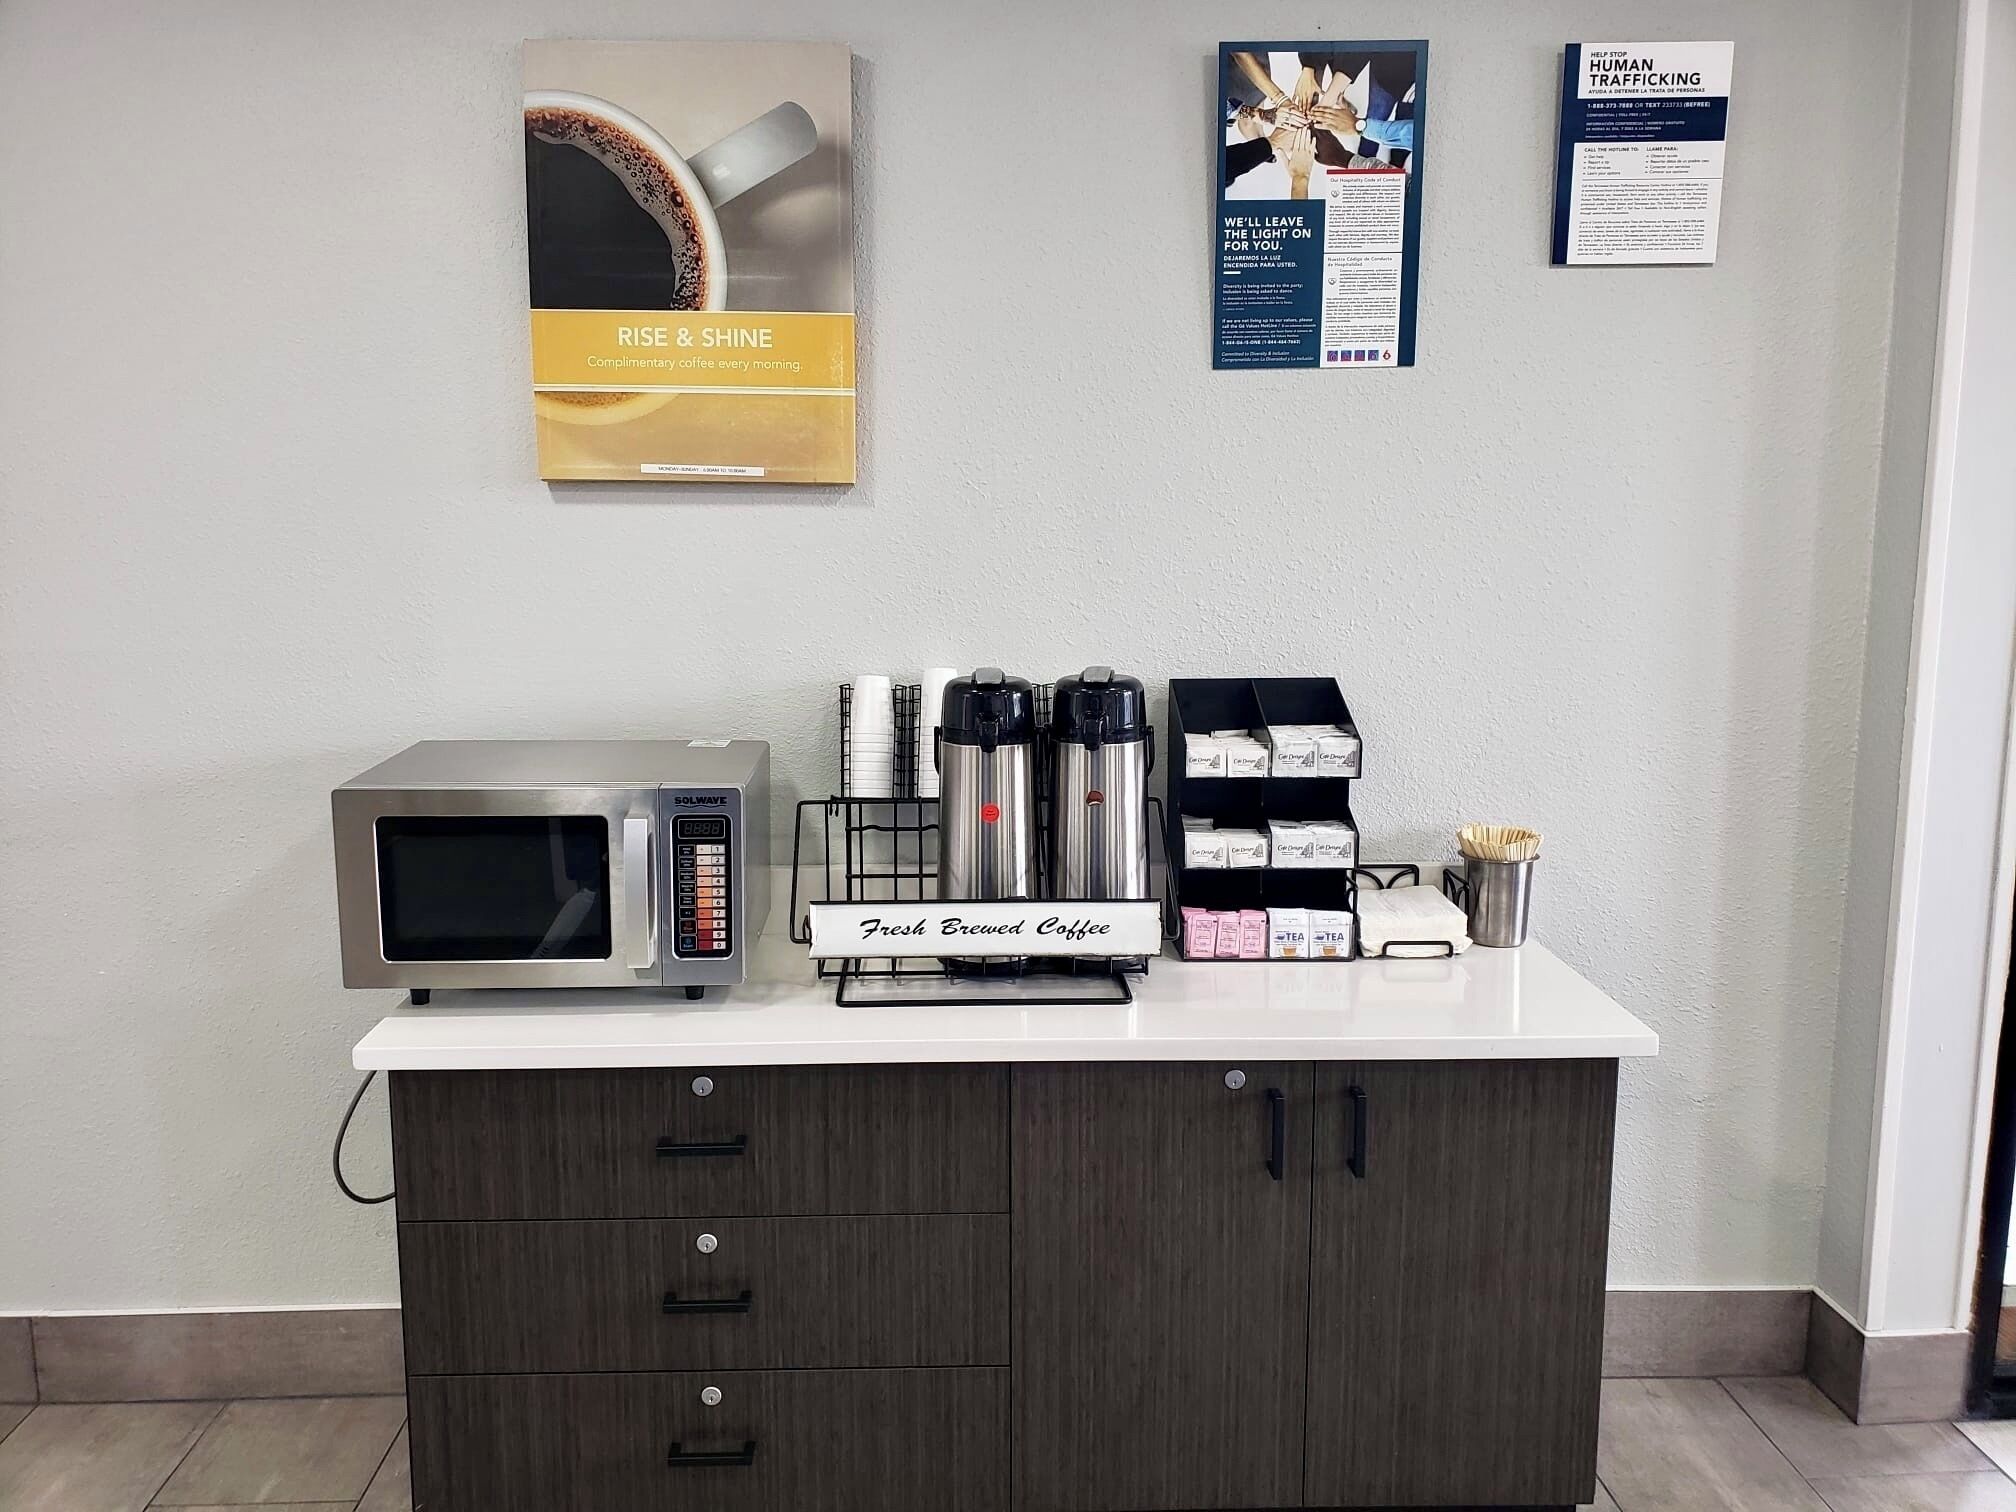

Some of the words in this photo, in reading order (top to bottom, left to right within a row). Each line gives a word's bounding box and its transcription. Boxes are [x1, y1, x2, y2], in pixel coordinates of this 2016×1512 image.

[1590, 58, 1653, 72] HUMAN
[1589, 72, 1701, 87] TRAFFICKING
[1224, 217, 1261, 227] WE'LL
[1265, 216, 1304, 227] LEAVE
[1224, 229, 1248, 239] THE
[1252, 229, 1288, 239] LIGHT
[1292, 228, 1312, 239] ON
[1224, 241, 1249, 251] FOR
[1253, 240, 1283, 251] YOU.
[618, 327, 668, 347] RISE
[676, 328, 693, 347] &
[701, 327, 773, 348] SHINE
[1383, 349, 1391, 360] 6
[587, 356, 676, 371] Complimentary
[678, 356, 715, 369] coffee
[718, 359, 750, 372] every
[753, 359, 803, 373] morning.
[674, 796, 727, 805] SOLWAVE
[860, 918, 927, 940] Fresh
[940, 917, 1024, 936] Brewed
[1036, 916, 1111, 941] Coffee
[1286, 932, 1304, 941] TEA
[1325, 932, 1344, 941] TEA
